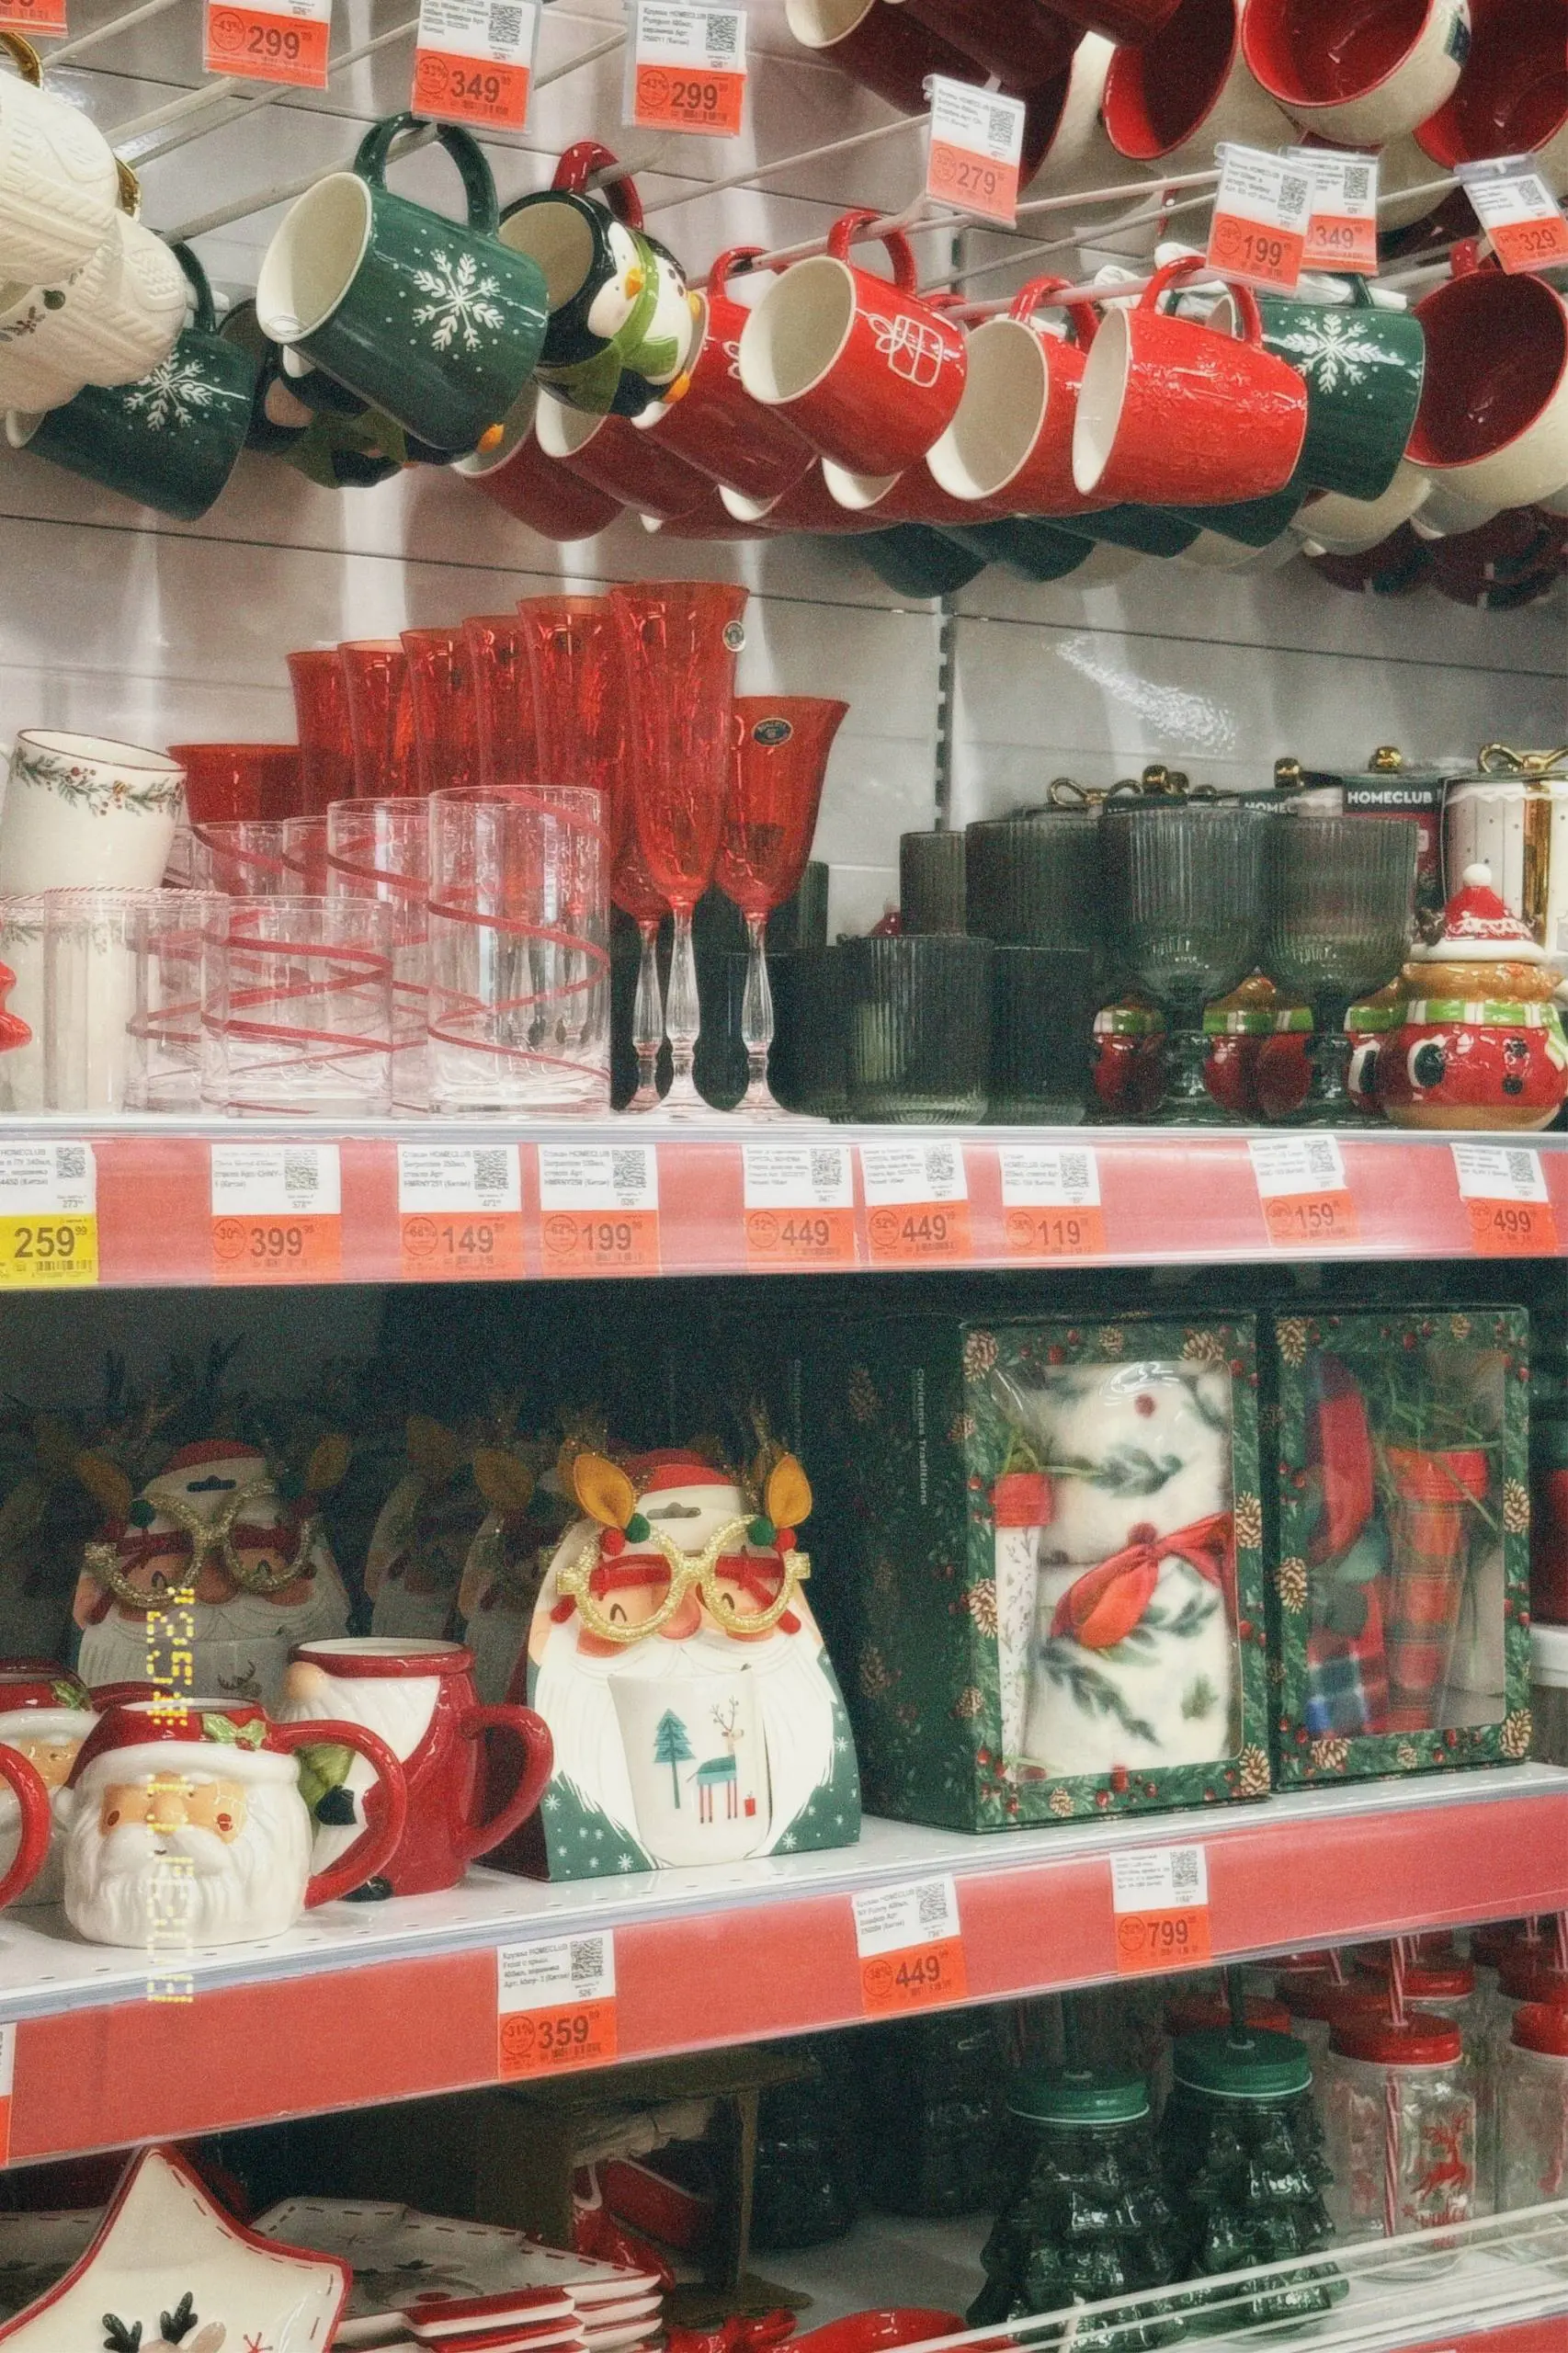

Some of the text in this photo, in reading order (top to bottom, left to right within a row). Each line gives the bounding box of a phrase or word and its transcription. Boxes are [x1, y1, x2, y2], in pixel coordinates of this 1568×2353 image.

[247, 26, 300, 60] 299
[450, 70, 501, 103] 349
[670, 81, 718, 110] 299
[957, 162, 995, 195] 279
[1244, 234, 1282, 267] 199
[1315, 224, 1354, 250] 349
[1519, 229, 1556, 251] 329
[1347, 790, 1434, 804] HOMECLUB
[902, 1214, 947, 1242] 449
[1295, 1202, 1334, 1230] 159
[1494, 1208, 1531, 1233] 499
[14, 1226, 75, 1257] 259
[250, 1227, 302, 1256] 399
[441, 1225, 494, 1254] 149
[582, 1222, 631, 1250] 199
[781, 1220, 830, 1246] 449
[1039, 1220, 1080, 1245] 119
[1146, 1918, 1188, 1948] 799
[895, 1955, 940, 1987] 449
[539, 2015, 589, 2049] 359
